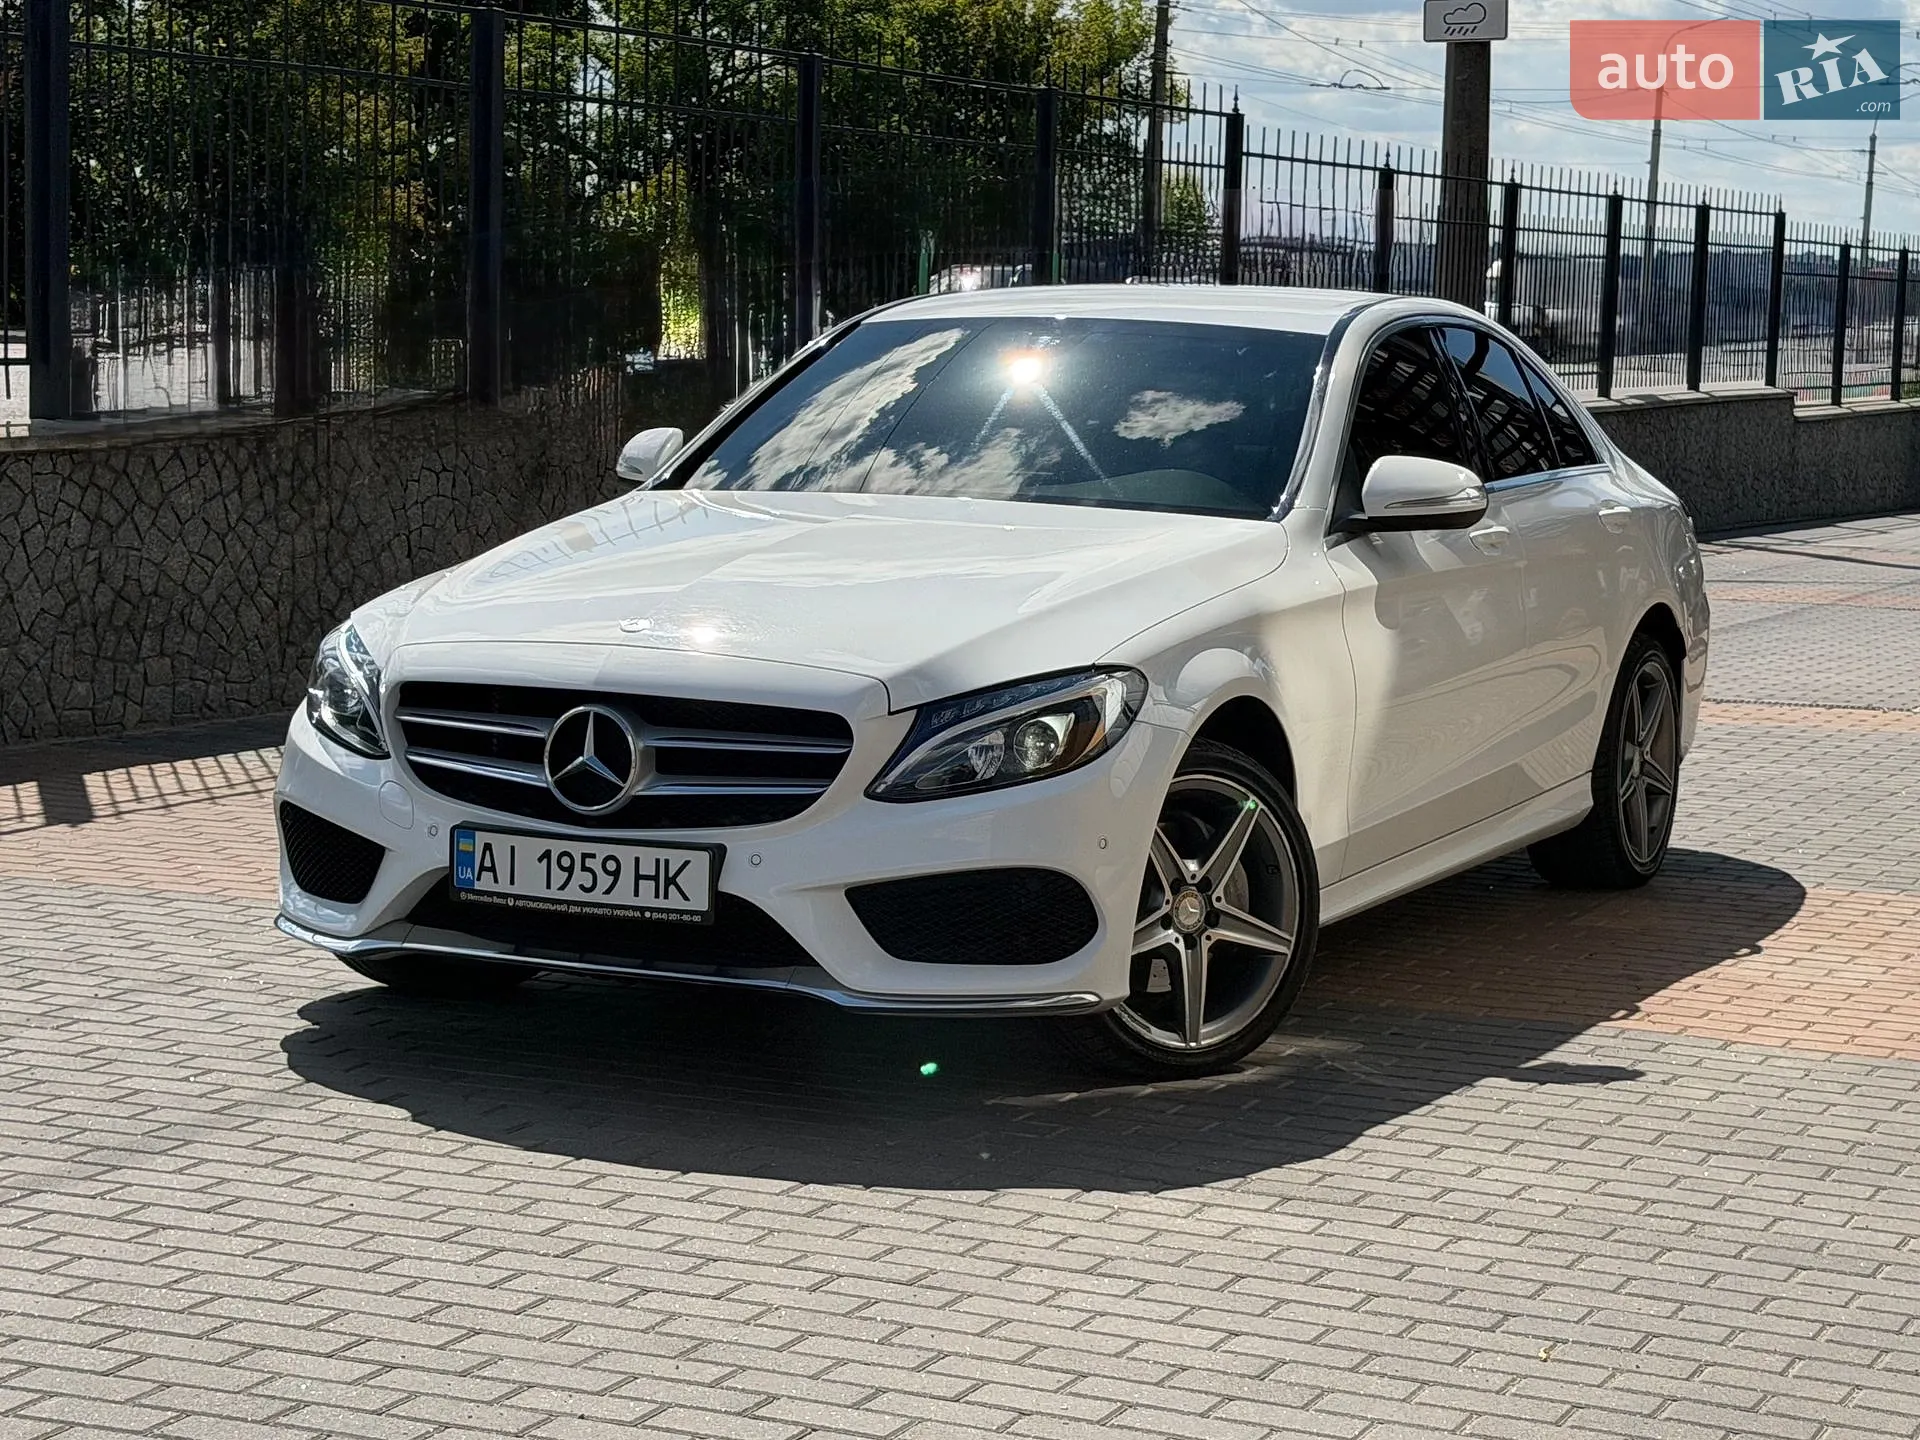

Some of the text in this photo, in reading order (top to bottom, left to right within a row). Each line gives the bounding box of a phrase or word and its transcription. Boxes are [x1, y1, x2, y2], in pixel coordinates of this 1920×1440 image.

[458, 866, 474, 881] UA
[476, 842, 692, 902] AI 1959 HK
[568, 903, 581, 913] ДІМ
[582, 905, 612, 916] УКРАВТО
[613, 908, 642, 918] УКРАЇНА
